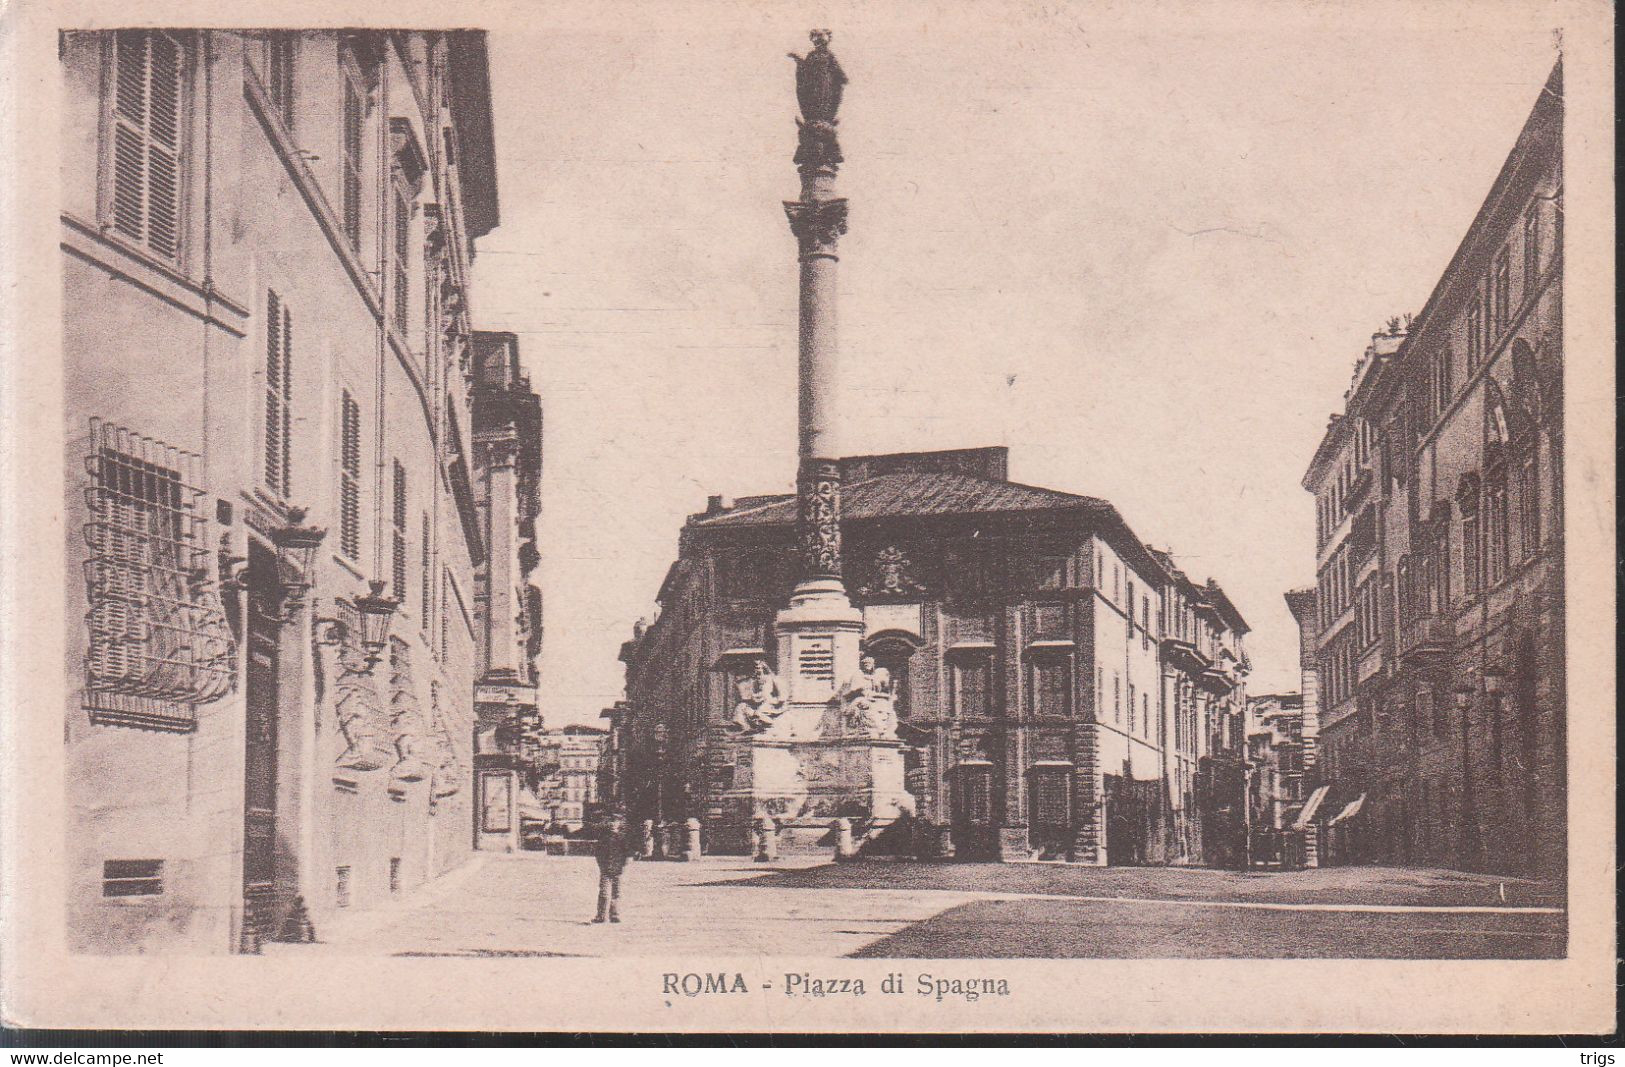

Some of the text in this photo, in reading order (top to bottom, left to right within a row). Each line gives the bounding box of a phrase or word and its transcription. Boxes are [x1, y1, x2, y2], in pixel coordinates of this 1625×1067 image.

[662, 972, 749, 995] ROMA
[784, 972, 866, 995] Piazza
[881, 972, 905, 994] di
[917, 973, 1010, 1002] Spagna
